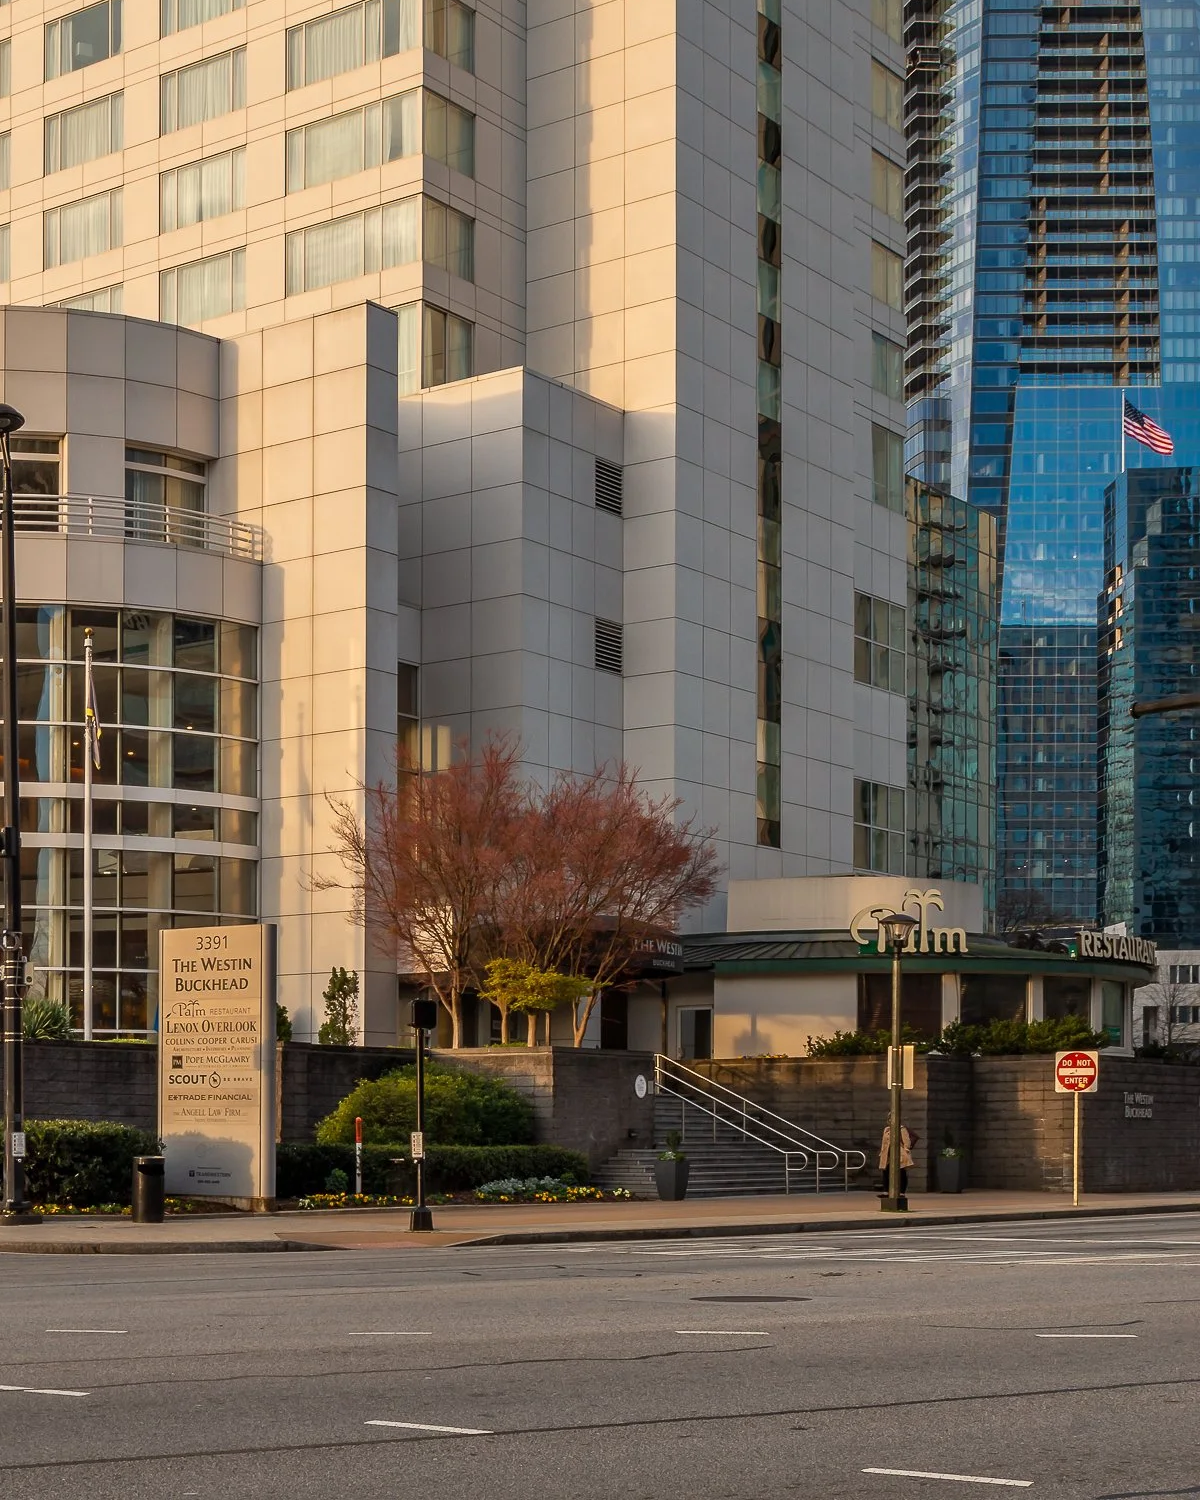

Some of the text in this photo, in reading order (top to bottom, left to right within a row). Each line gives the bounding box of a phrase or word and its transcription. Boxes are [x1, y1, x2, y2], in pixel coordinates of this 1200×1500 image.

[196, 935, 228, 950] 3391
[1078, 930, 1158, 965] RESTAURANT
[172, 957, 252, 972] THE WESTIN
[175, 978, 248, 992] BUCKHEAD
[210, 1007, 251, 1016] RESTAURANT
[166, 1019, 257, 1033] LENOX OVERLOOK
[165, 1036, 257, 1045] COLLINS COOPER CARUSI
[185, 1055, 204, 1064] POPE
[1062, 1059, 1091, 1067] DO NOT
[168, 1074, 207, 1084] SCOUT
[208, 1107, 222, 1116] LAW
[224, 1107, 241, 1116] FIRM
